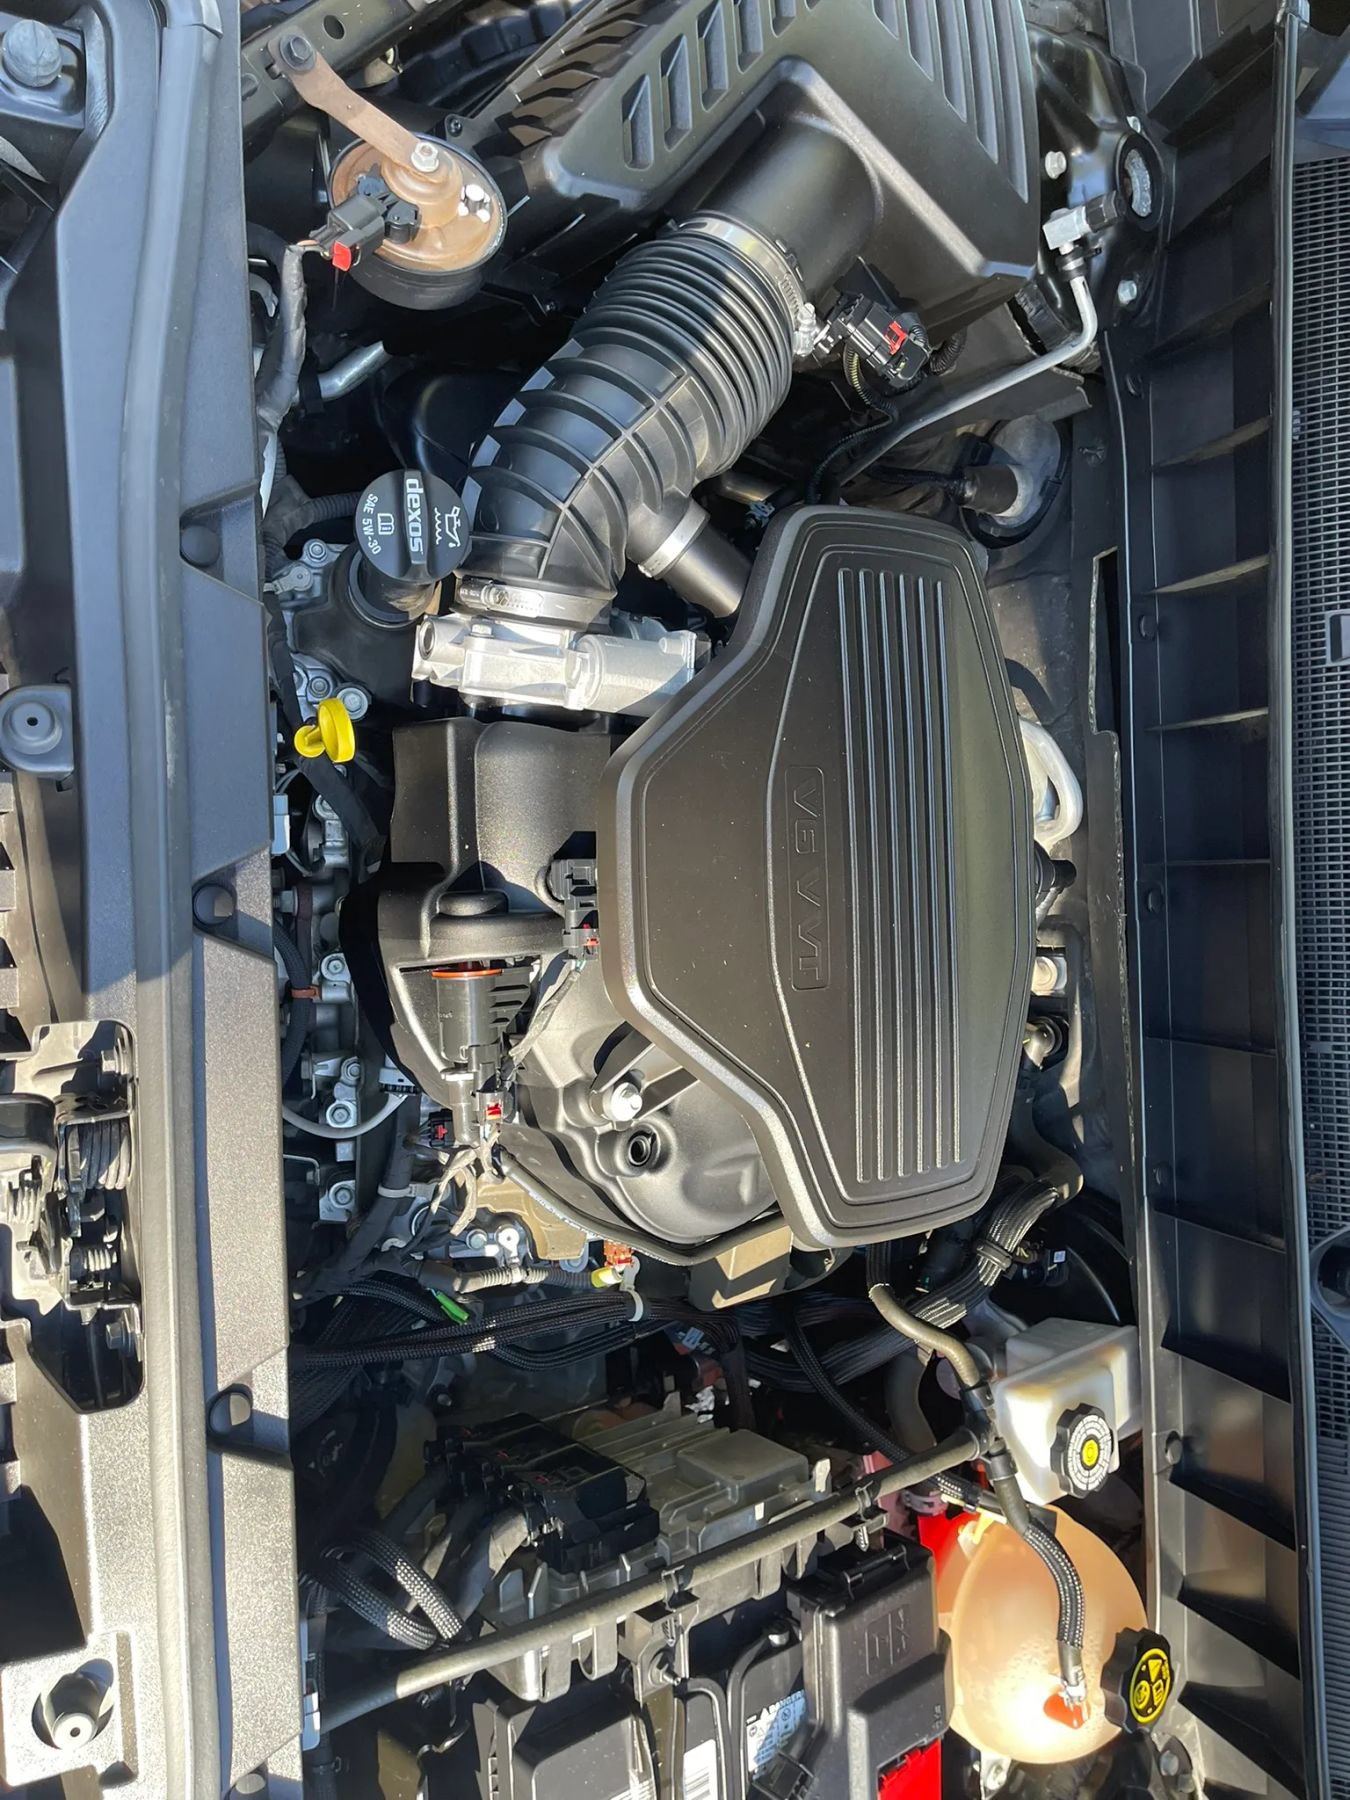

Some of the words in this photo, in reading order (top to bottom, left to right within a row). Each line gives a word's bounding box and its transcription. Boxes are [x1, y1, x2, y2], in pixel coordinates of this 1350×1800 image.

[363, 493, 378, 514] SAE
[406, 478, 424, 554] dexos
[362, 518, 381, 554] 5W-30
[793, 776, 819, 854] V6
